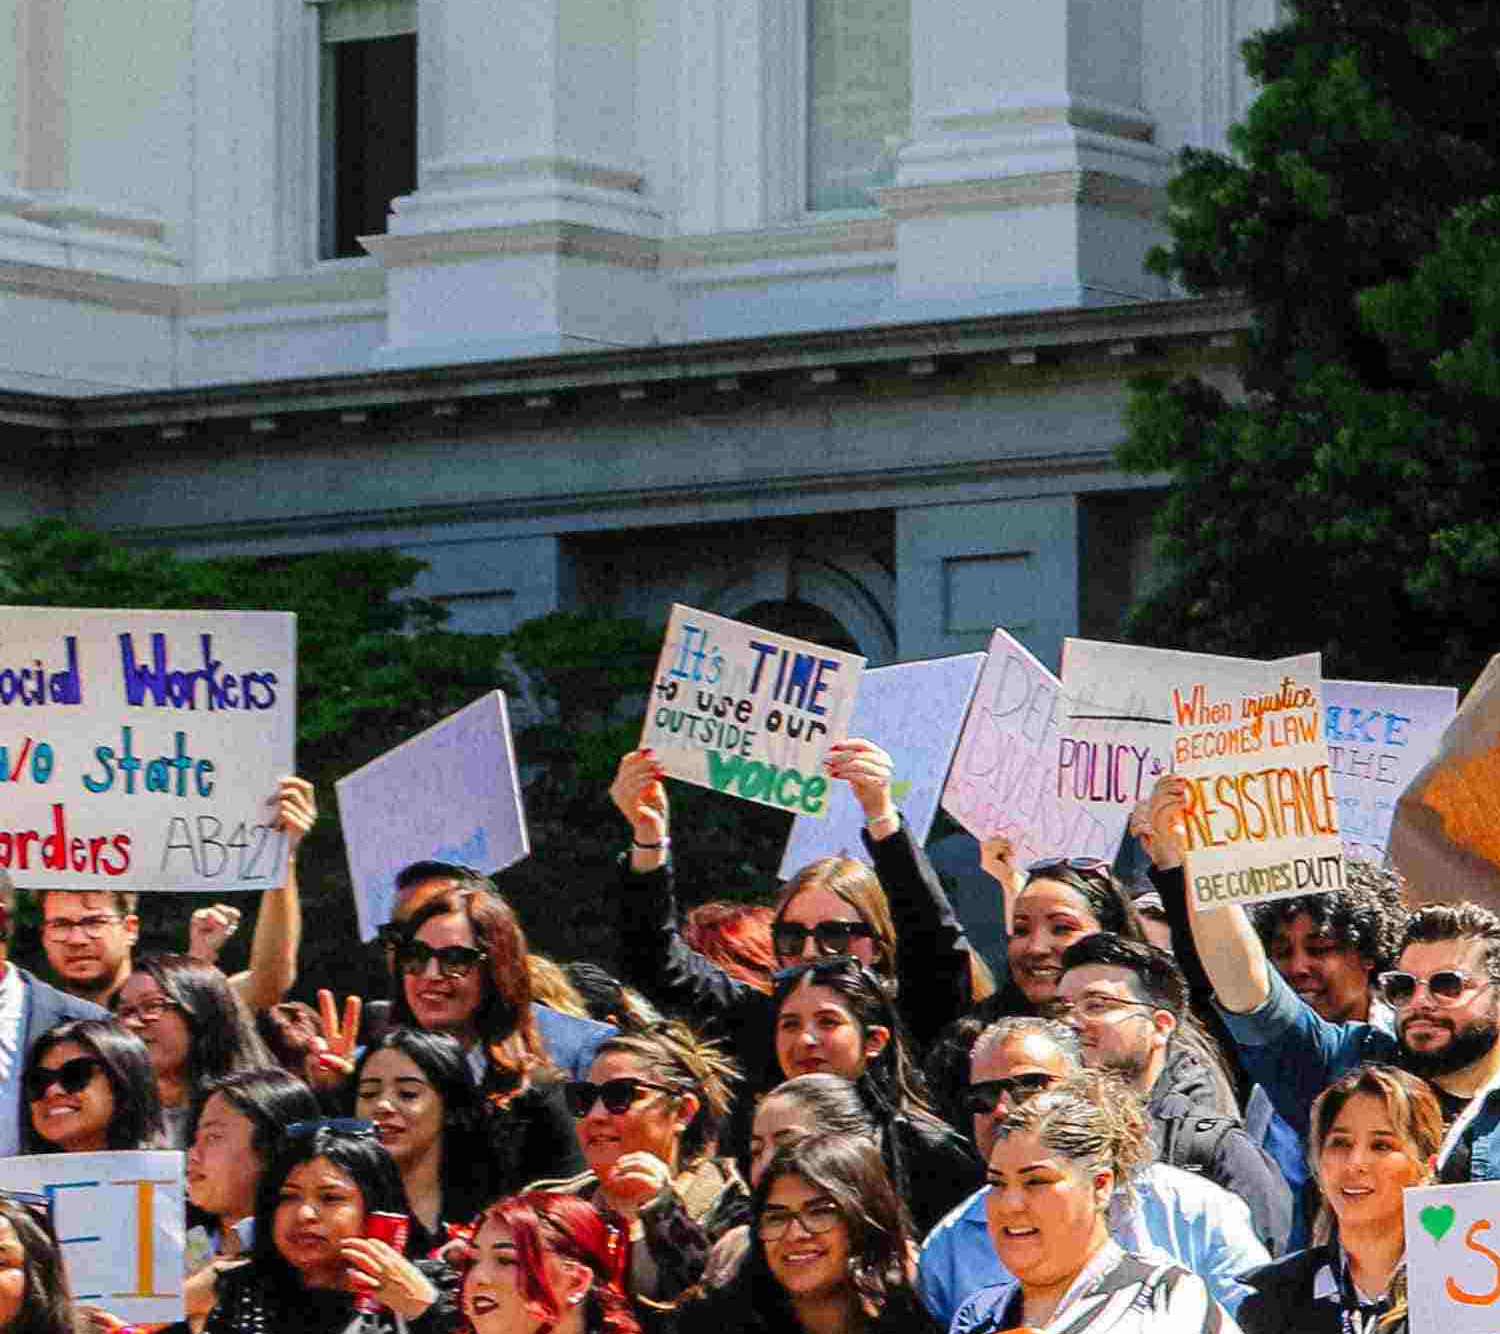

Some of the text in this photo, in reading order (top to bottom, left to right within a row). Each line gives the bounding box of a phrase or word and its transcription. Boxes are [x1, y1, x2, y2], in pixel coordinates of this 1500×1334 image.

[118, 633, 278, 710] Workers
[670, 625, 840, 715] It's TIME
[656, 677, 827, 742] to use our
[656, 707, 754, 755] OUTSIDE
[1173, 683, 1232, 725] When
[1175, 712, 1318, 763] BECOMES LAW
[1058, 738, 1151, 803] POLICY
[1183, 765, 1339, 851] RESISTANCE
[1195, 855, 1344, 903] BECOMES DUTY
